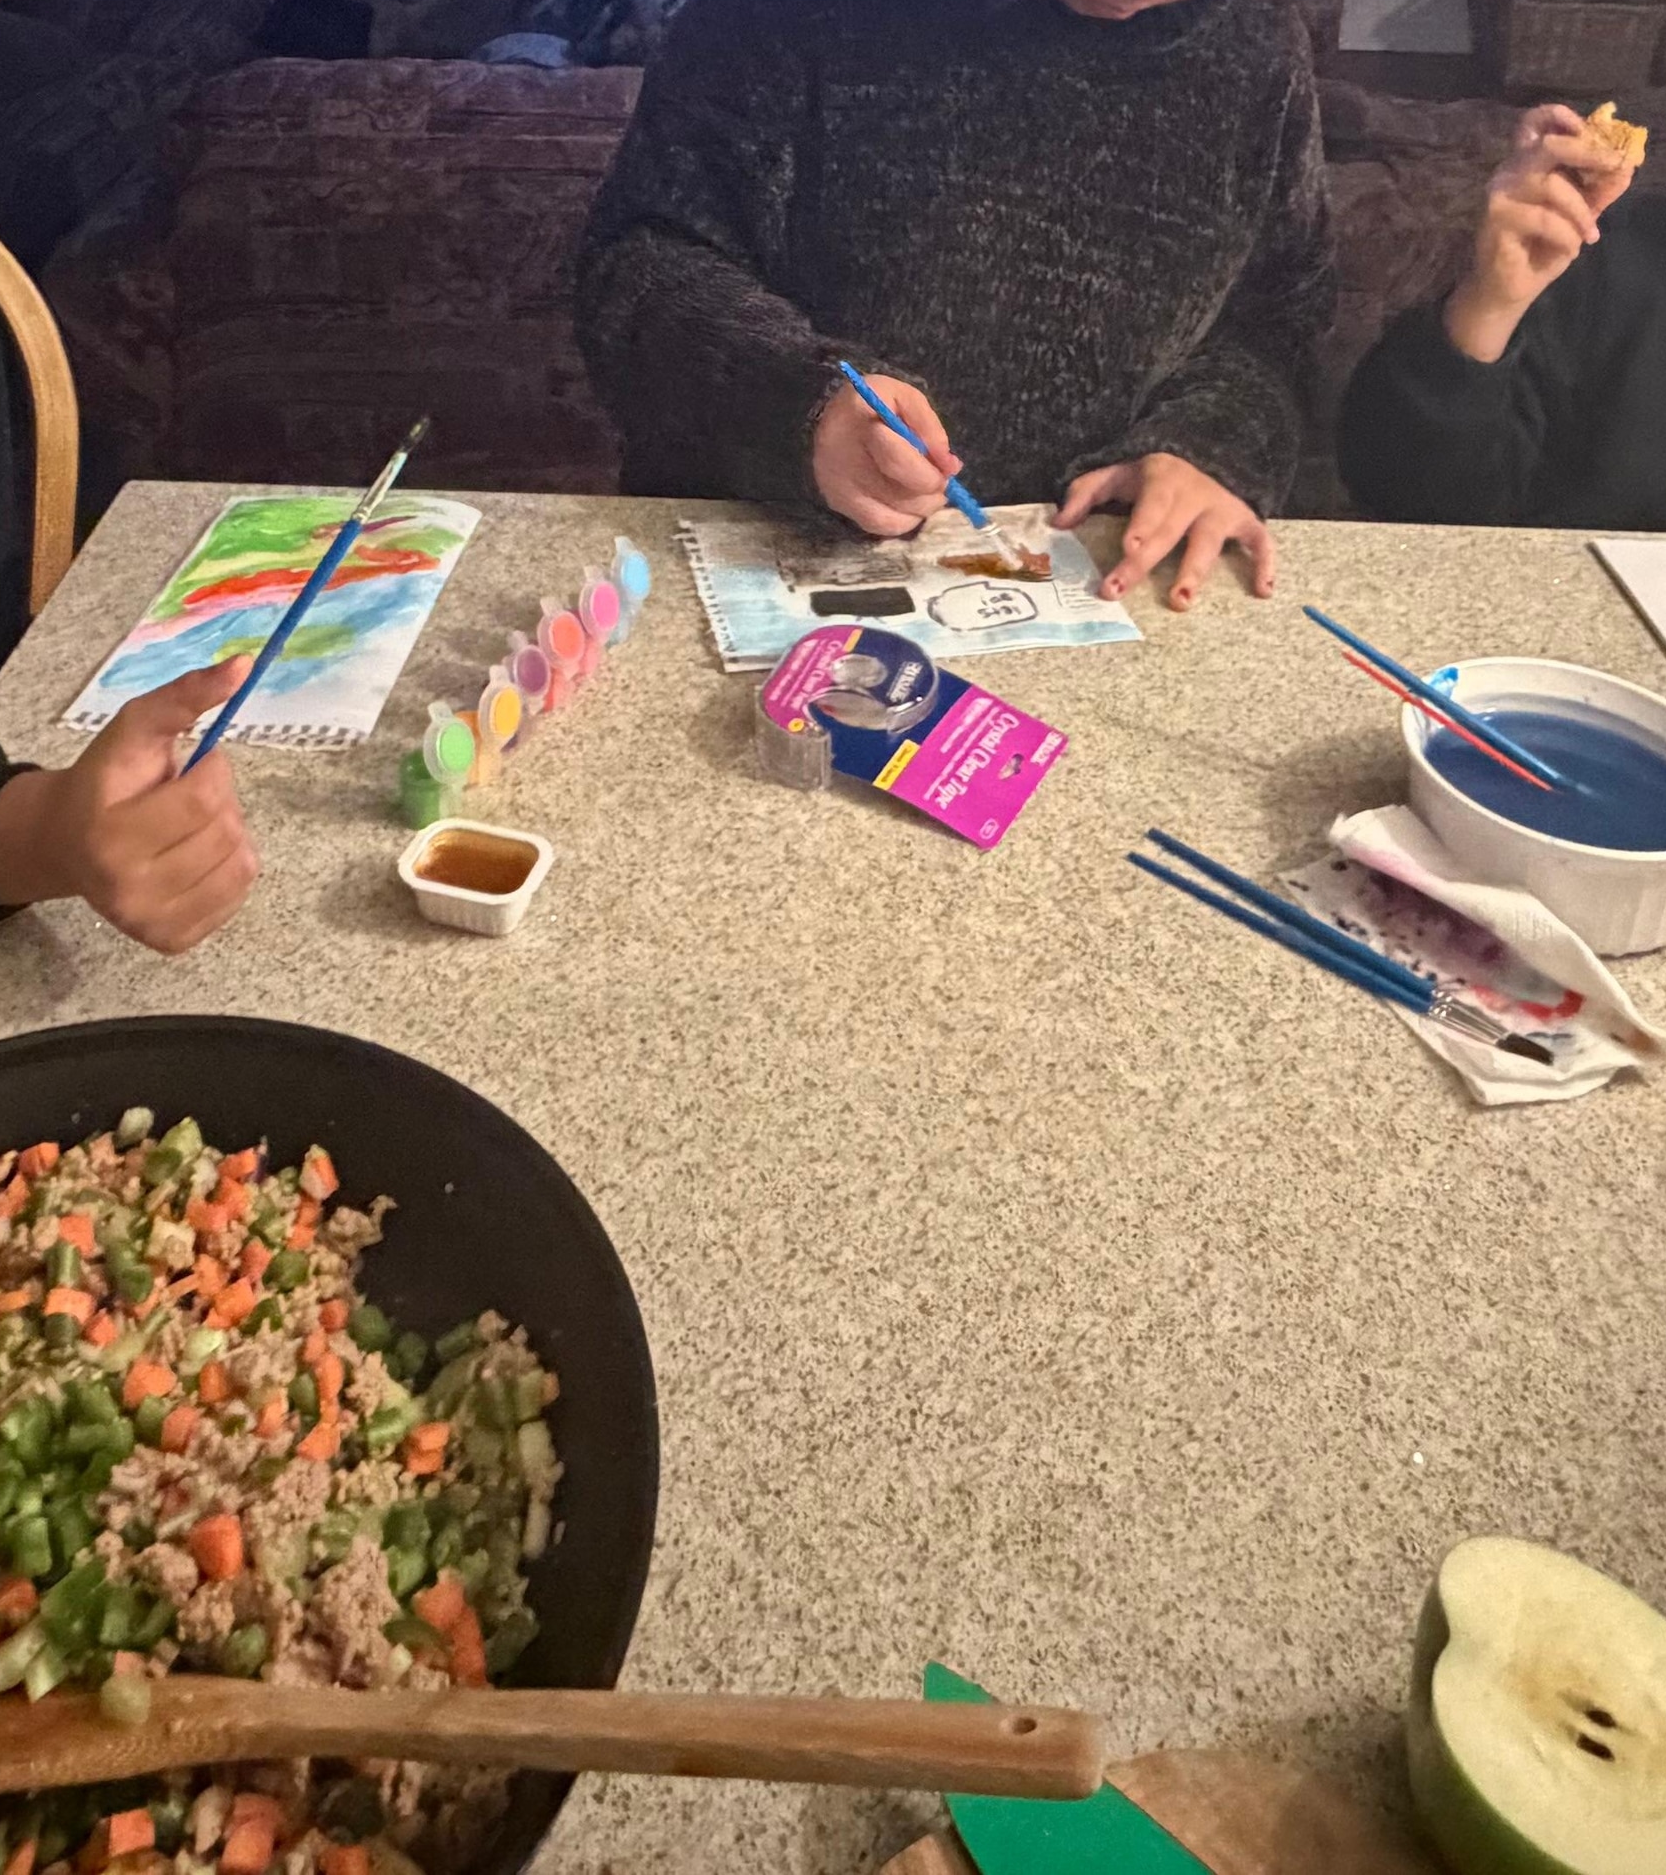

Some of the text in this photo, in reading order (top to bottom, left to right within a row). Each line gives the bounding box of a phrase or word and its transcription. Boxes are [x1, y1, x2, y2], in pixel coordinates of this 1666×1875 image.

[979, 712, 1019, 755] Crystal
[955, 747, 990, 783] Clear
[935, 777, 968, 810] Tape
